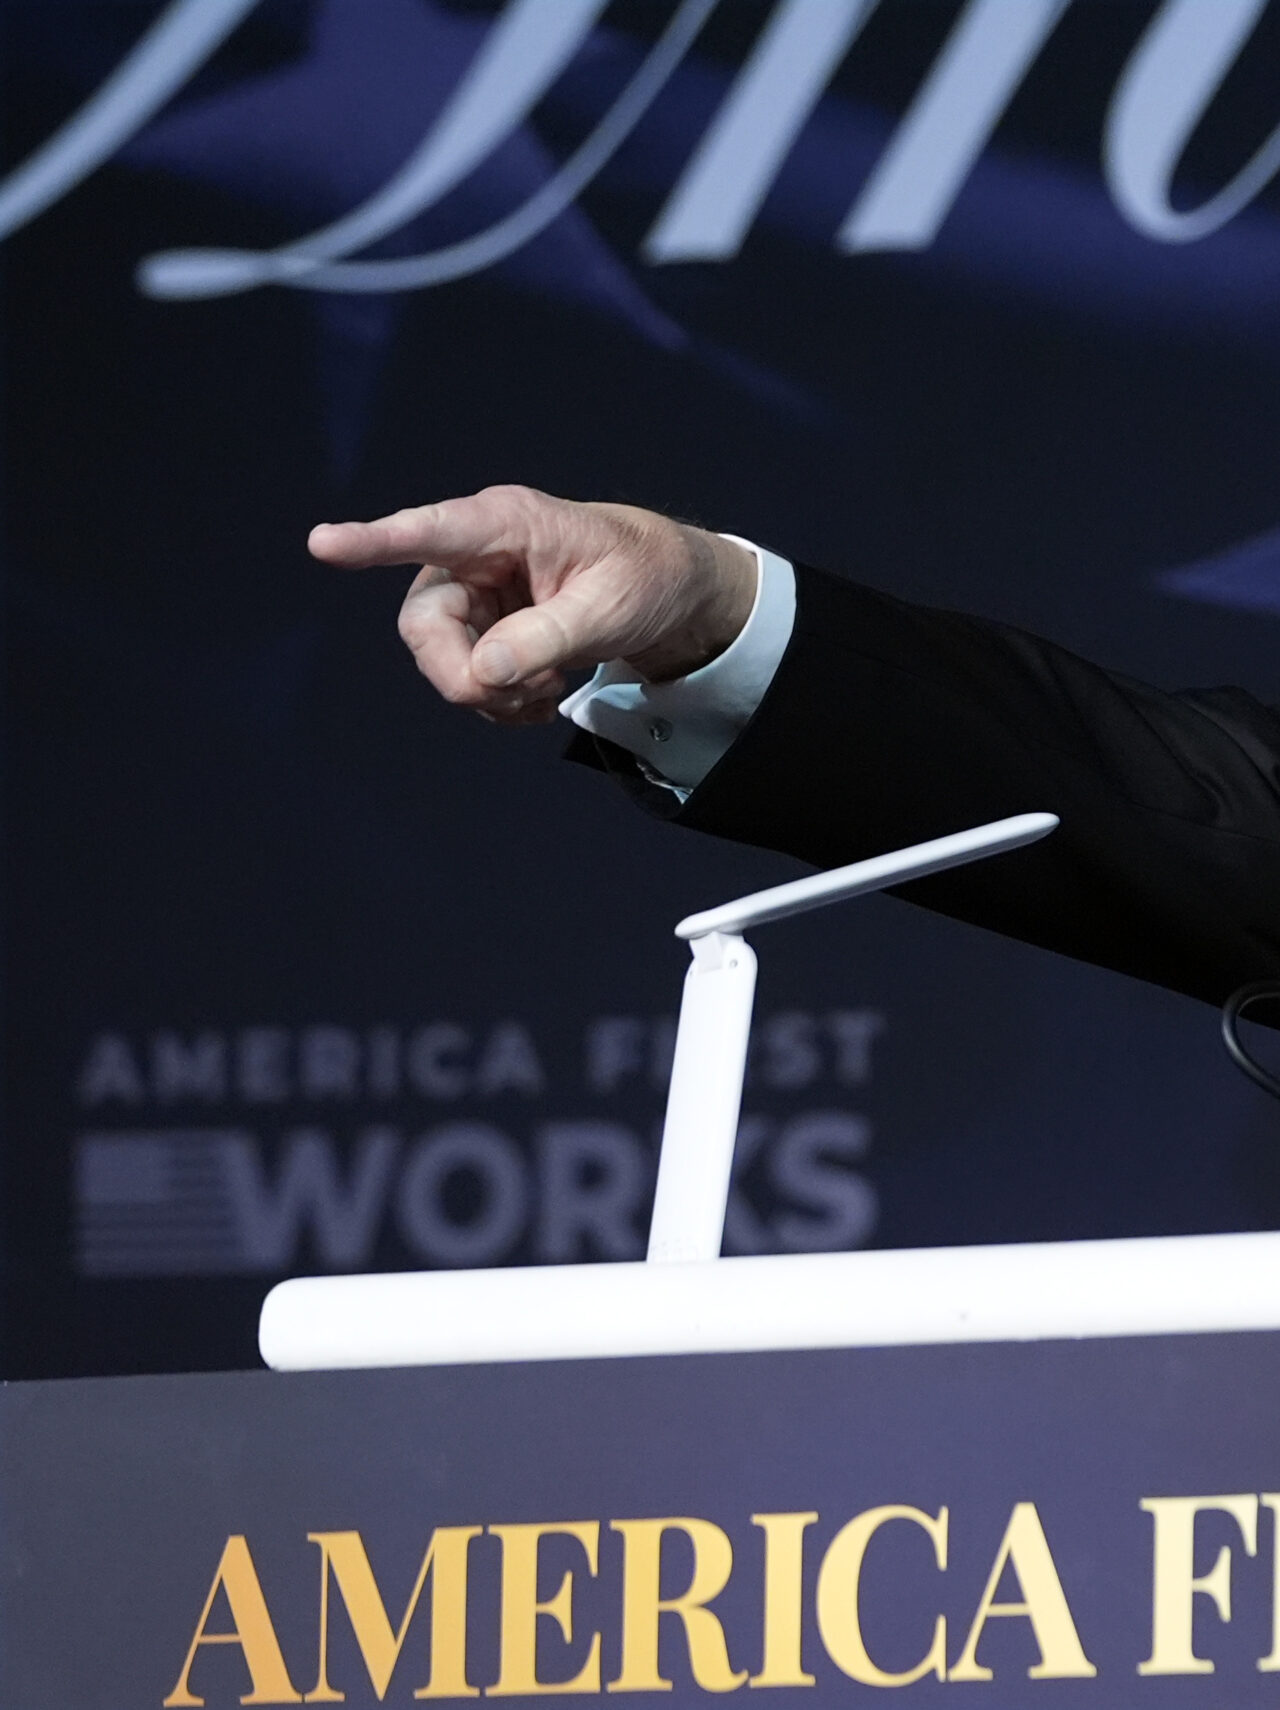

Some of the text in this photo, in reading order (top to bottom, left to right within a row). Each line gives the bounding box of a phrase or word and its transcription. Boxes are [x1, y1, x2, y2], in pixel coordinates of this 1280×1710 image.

[84, 1011, 884, 1100] AMERICA FIST
[163, 1501, 1097, 1708] AMERICA
